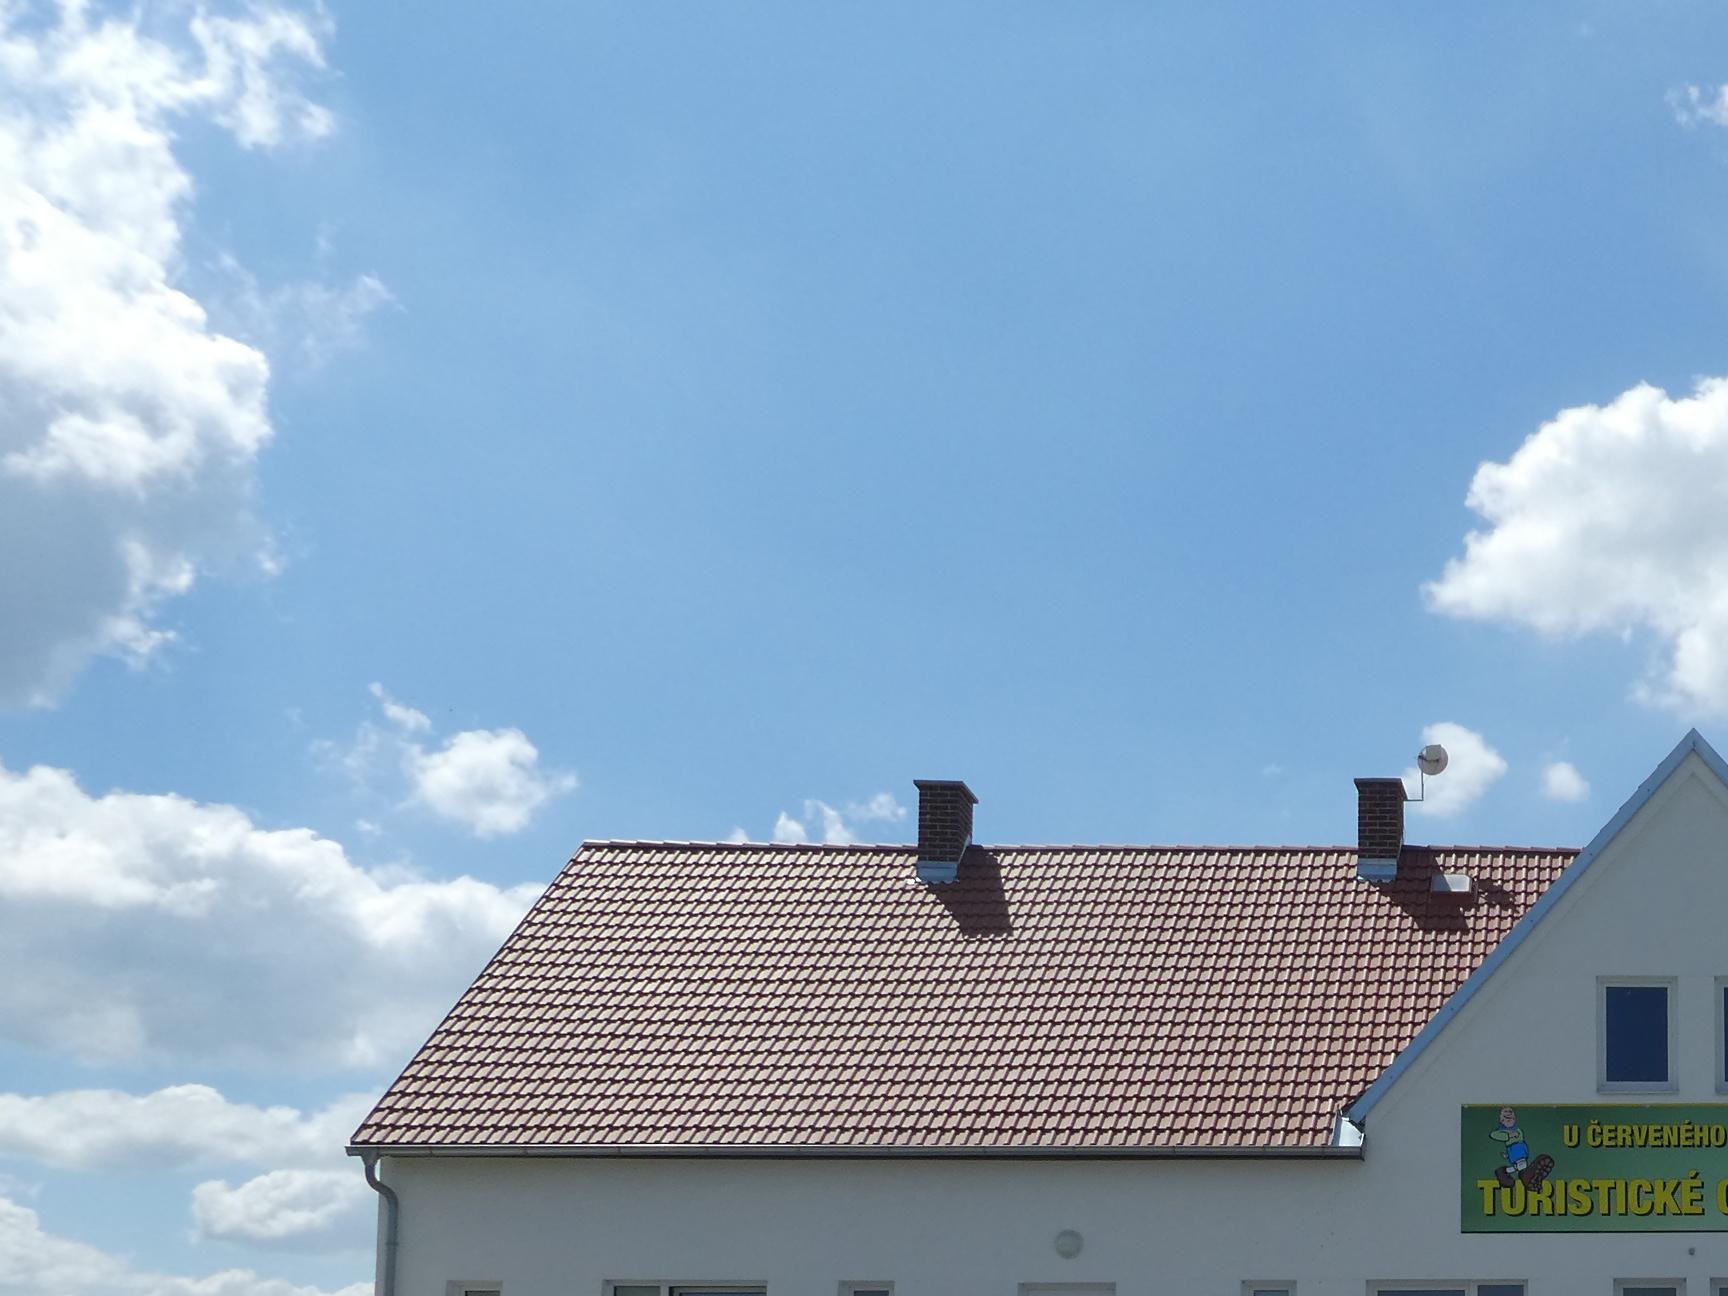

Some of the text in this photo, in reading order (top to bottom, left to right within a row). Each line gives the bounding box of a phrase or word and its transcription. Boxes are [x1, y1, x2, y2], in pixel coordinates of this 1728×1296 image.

[1563, 1124, 1580, 1147] U
[1587, 1119, 1728, 1147] ČERVENÉHO
[1477, 1169, 1705, 1216] TURISTICKÉ
